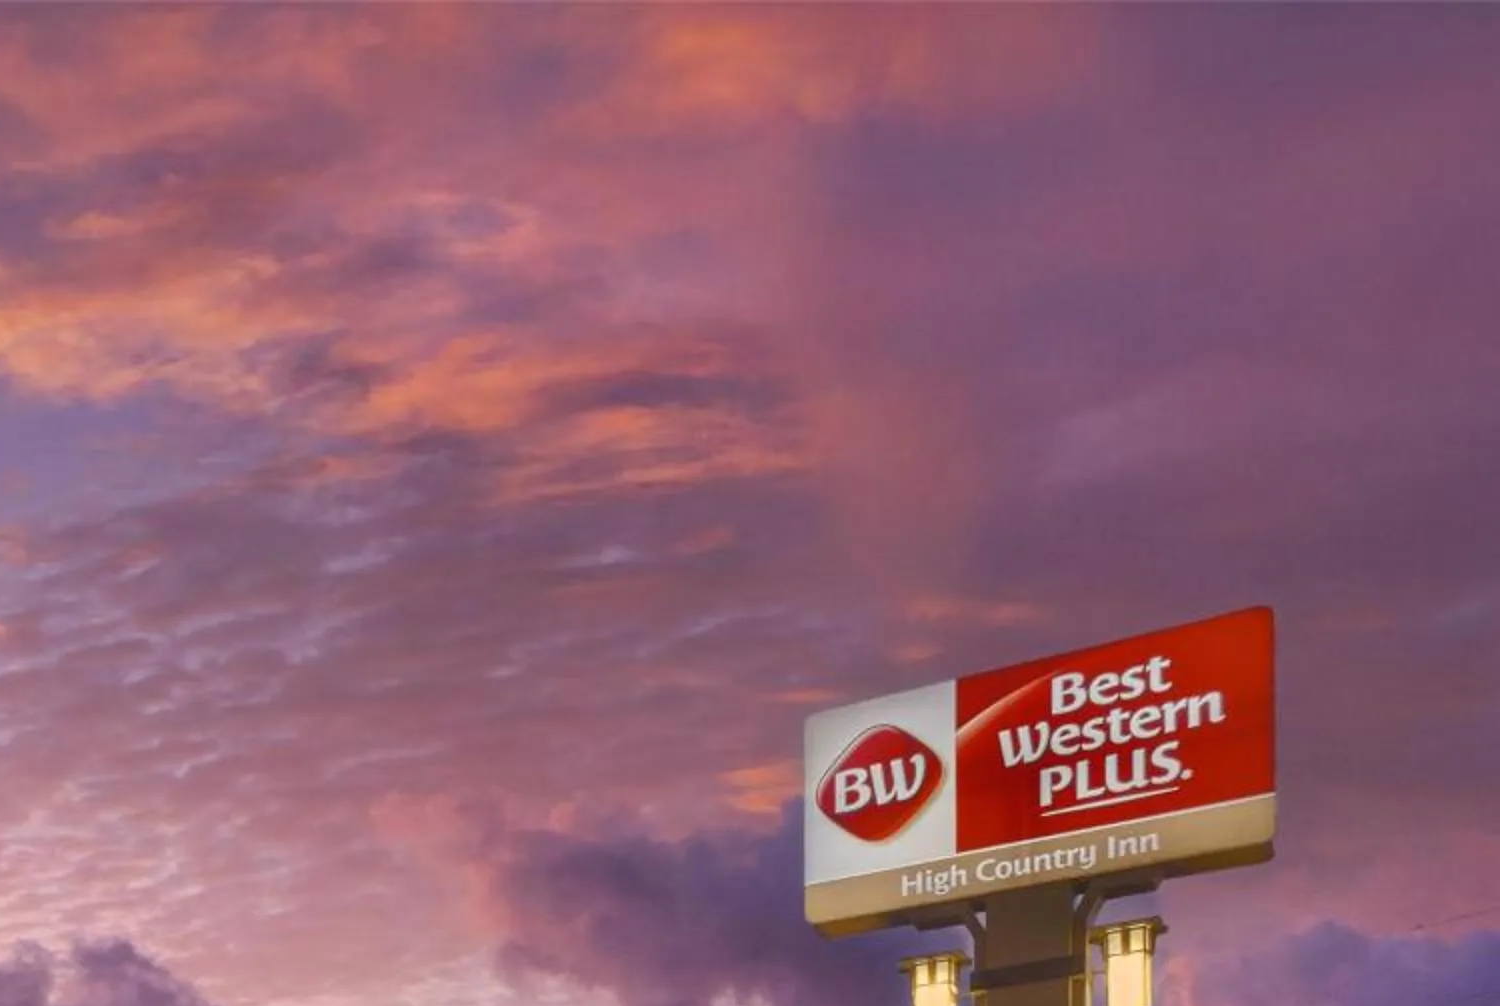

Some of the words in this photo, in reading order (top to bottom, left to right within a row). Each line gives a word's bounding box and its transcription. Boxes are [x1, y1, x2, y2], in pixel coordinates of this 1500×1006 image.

[1051, 655, 1172, 716] Best
[998, 692, 1226, 768] Western
[834, 754, 925, 814] BW
[901, 860, 967, 897] High
[975, 844, 1096, 883] Country
[1107, 832, 1159, 859] Inn
